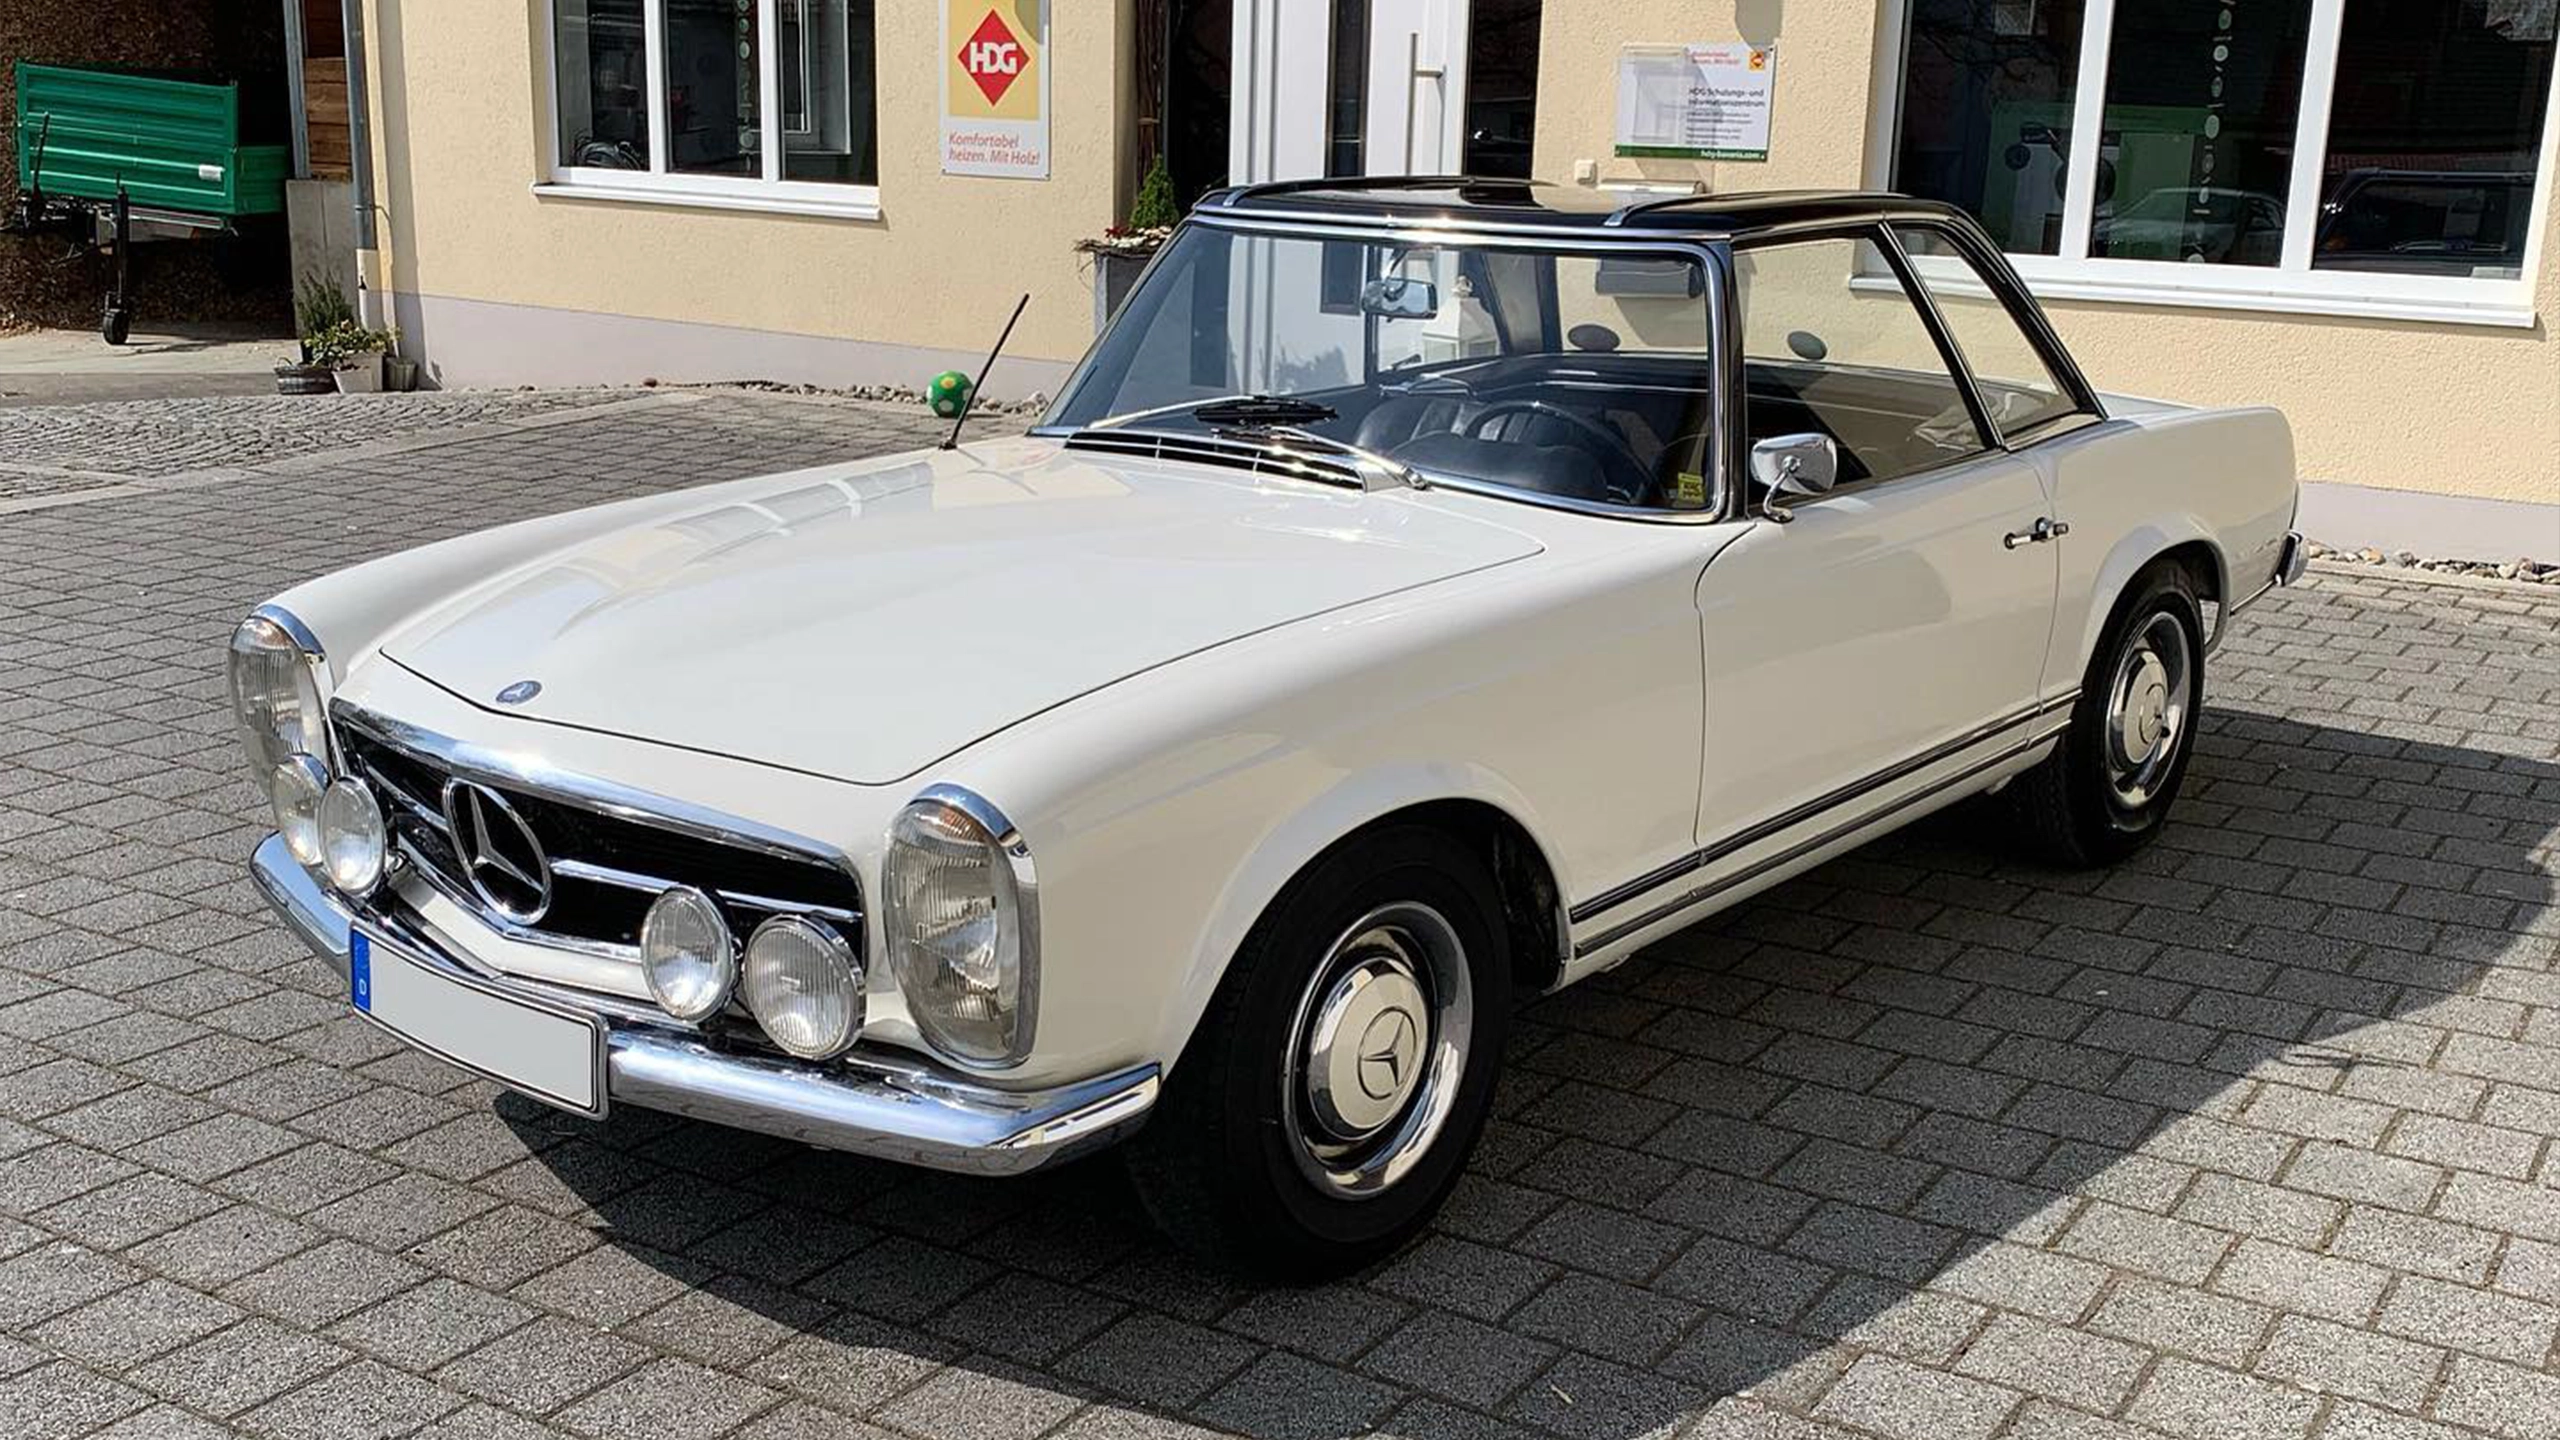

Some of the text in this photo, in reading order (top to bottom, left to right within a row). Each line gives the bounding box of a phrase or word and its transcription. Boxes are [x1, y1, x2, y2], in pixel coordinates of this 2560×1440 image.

[970, 42, 1017, 74] HDG
[1748, 88, 1765, 97] und
[949, 132, 1019, 149] Komfortabel
[949, 147, 1040, 165] heizen. Mit Holz!
[359, 978, 367, 996] D
